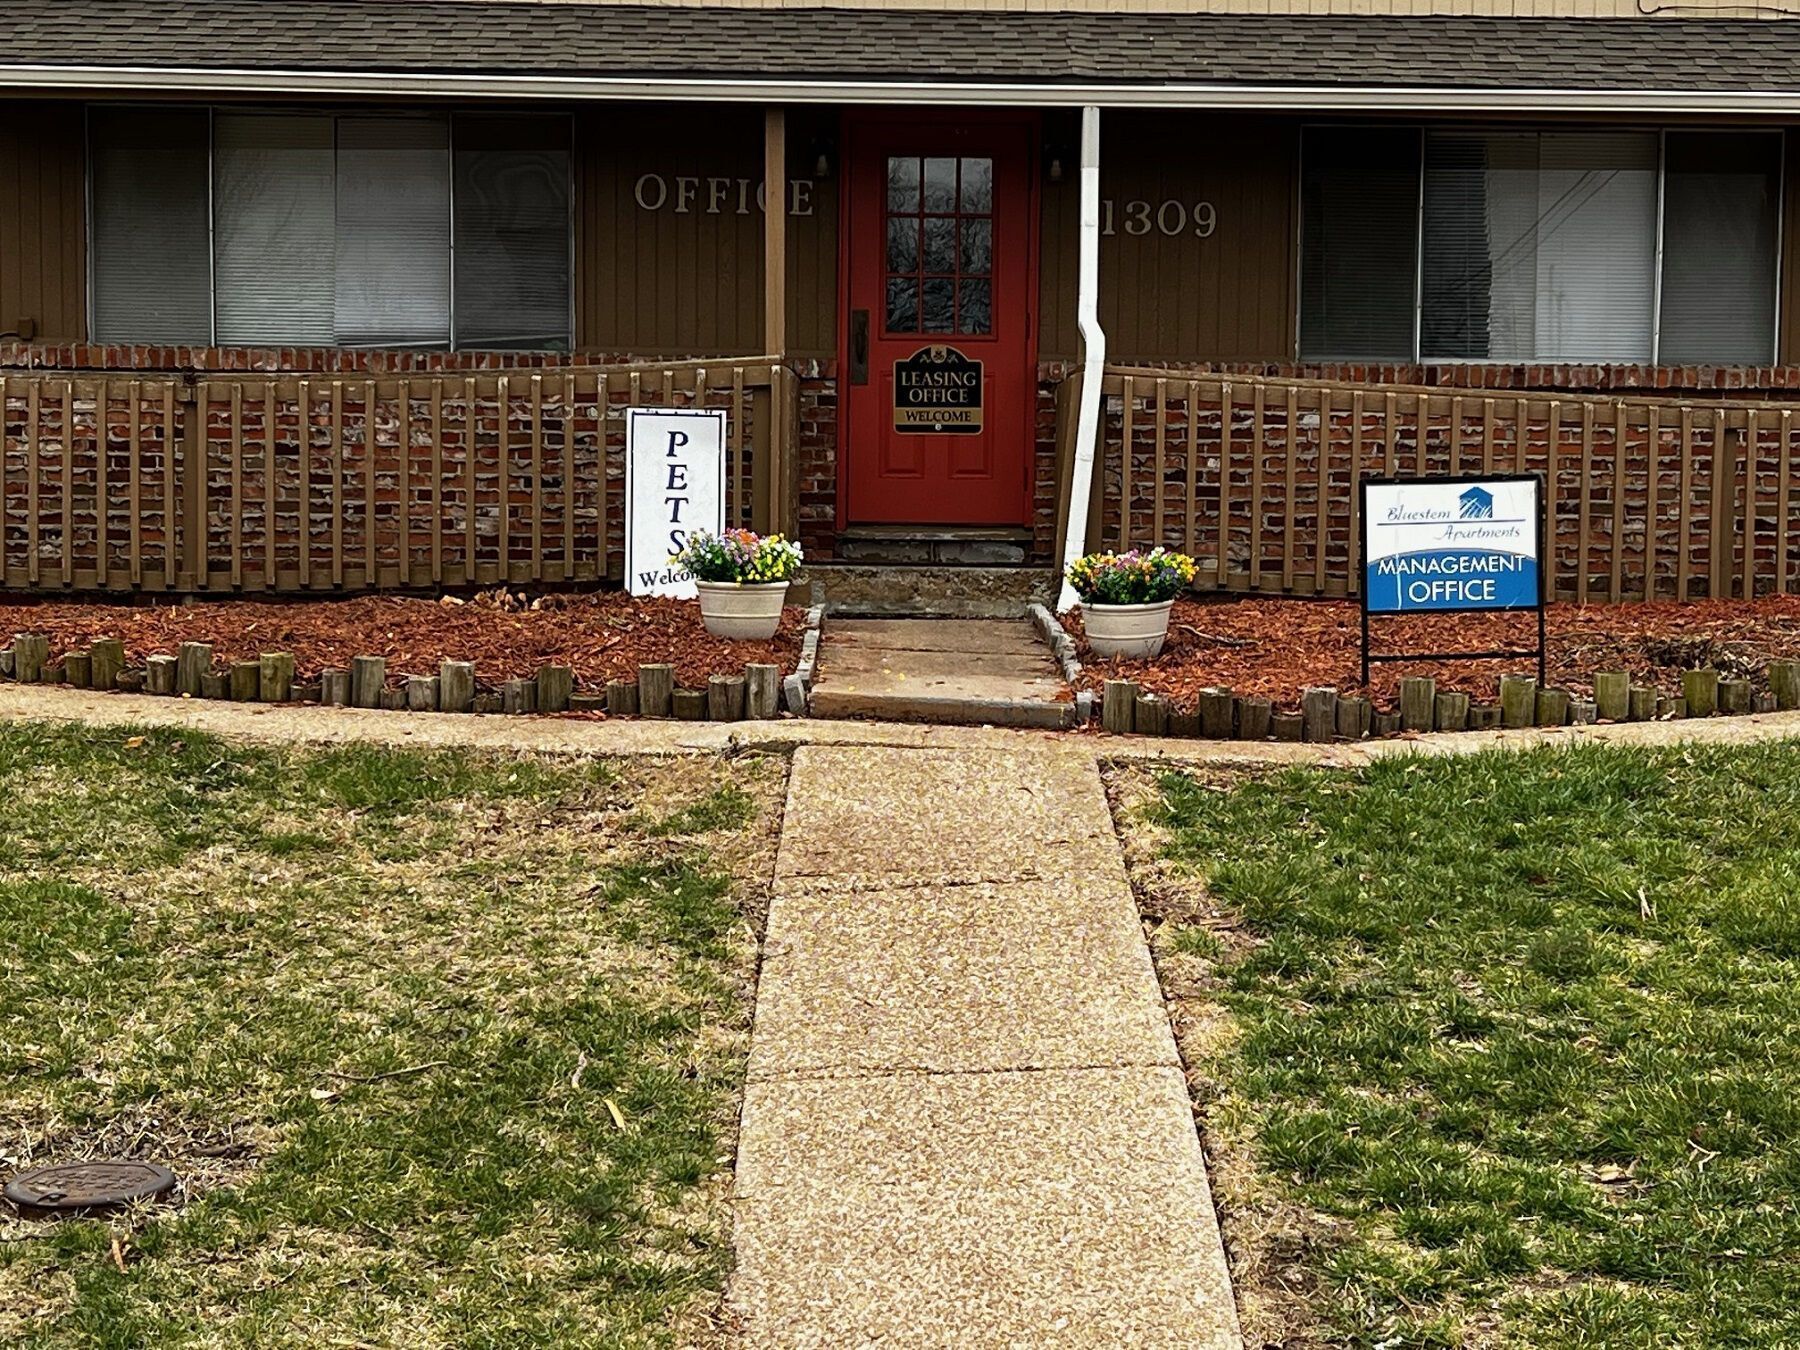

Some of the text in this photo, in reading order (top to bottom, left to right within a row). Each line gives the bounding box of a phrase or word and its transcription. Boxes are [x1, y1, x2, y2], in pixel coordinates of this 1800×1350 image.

[1101, 200, 1217, 237] 1309
[901, 371, 976, 386] LEASING
[909, 388, 968, 403] OFFICE
[905, 410, 971, 423] WELCOME
[664, 430, 690, 556] PETS
[1387, 504, 1451, 521] Bluestem
[1434, 525, 1520, 541] Apartments
[1377, 555, 1526, 577] MANAGEMENT
[1408, 579, 1496, 603] OFFICE
